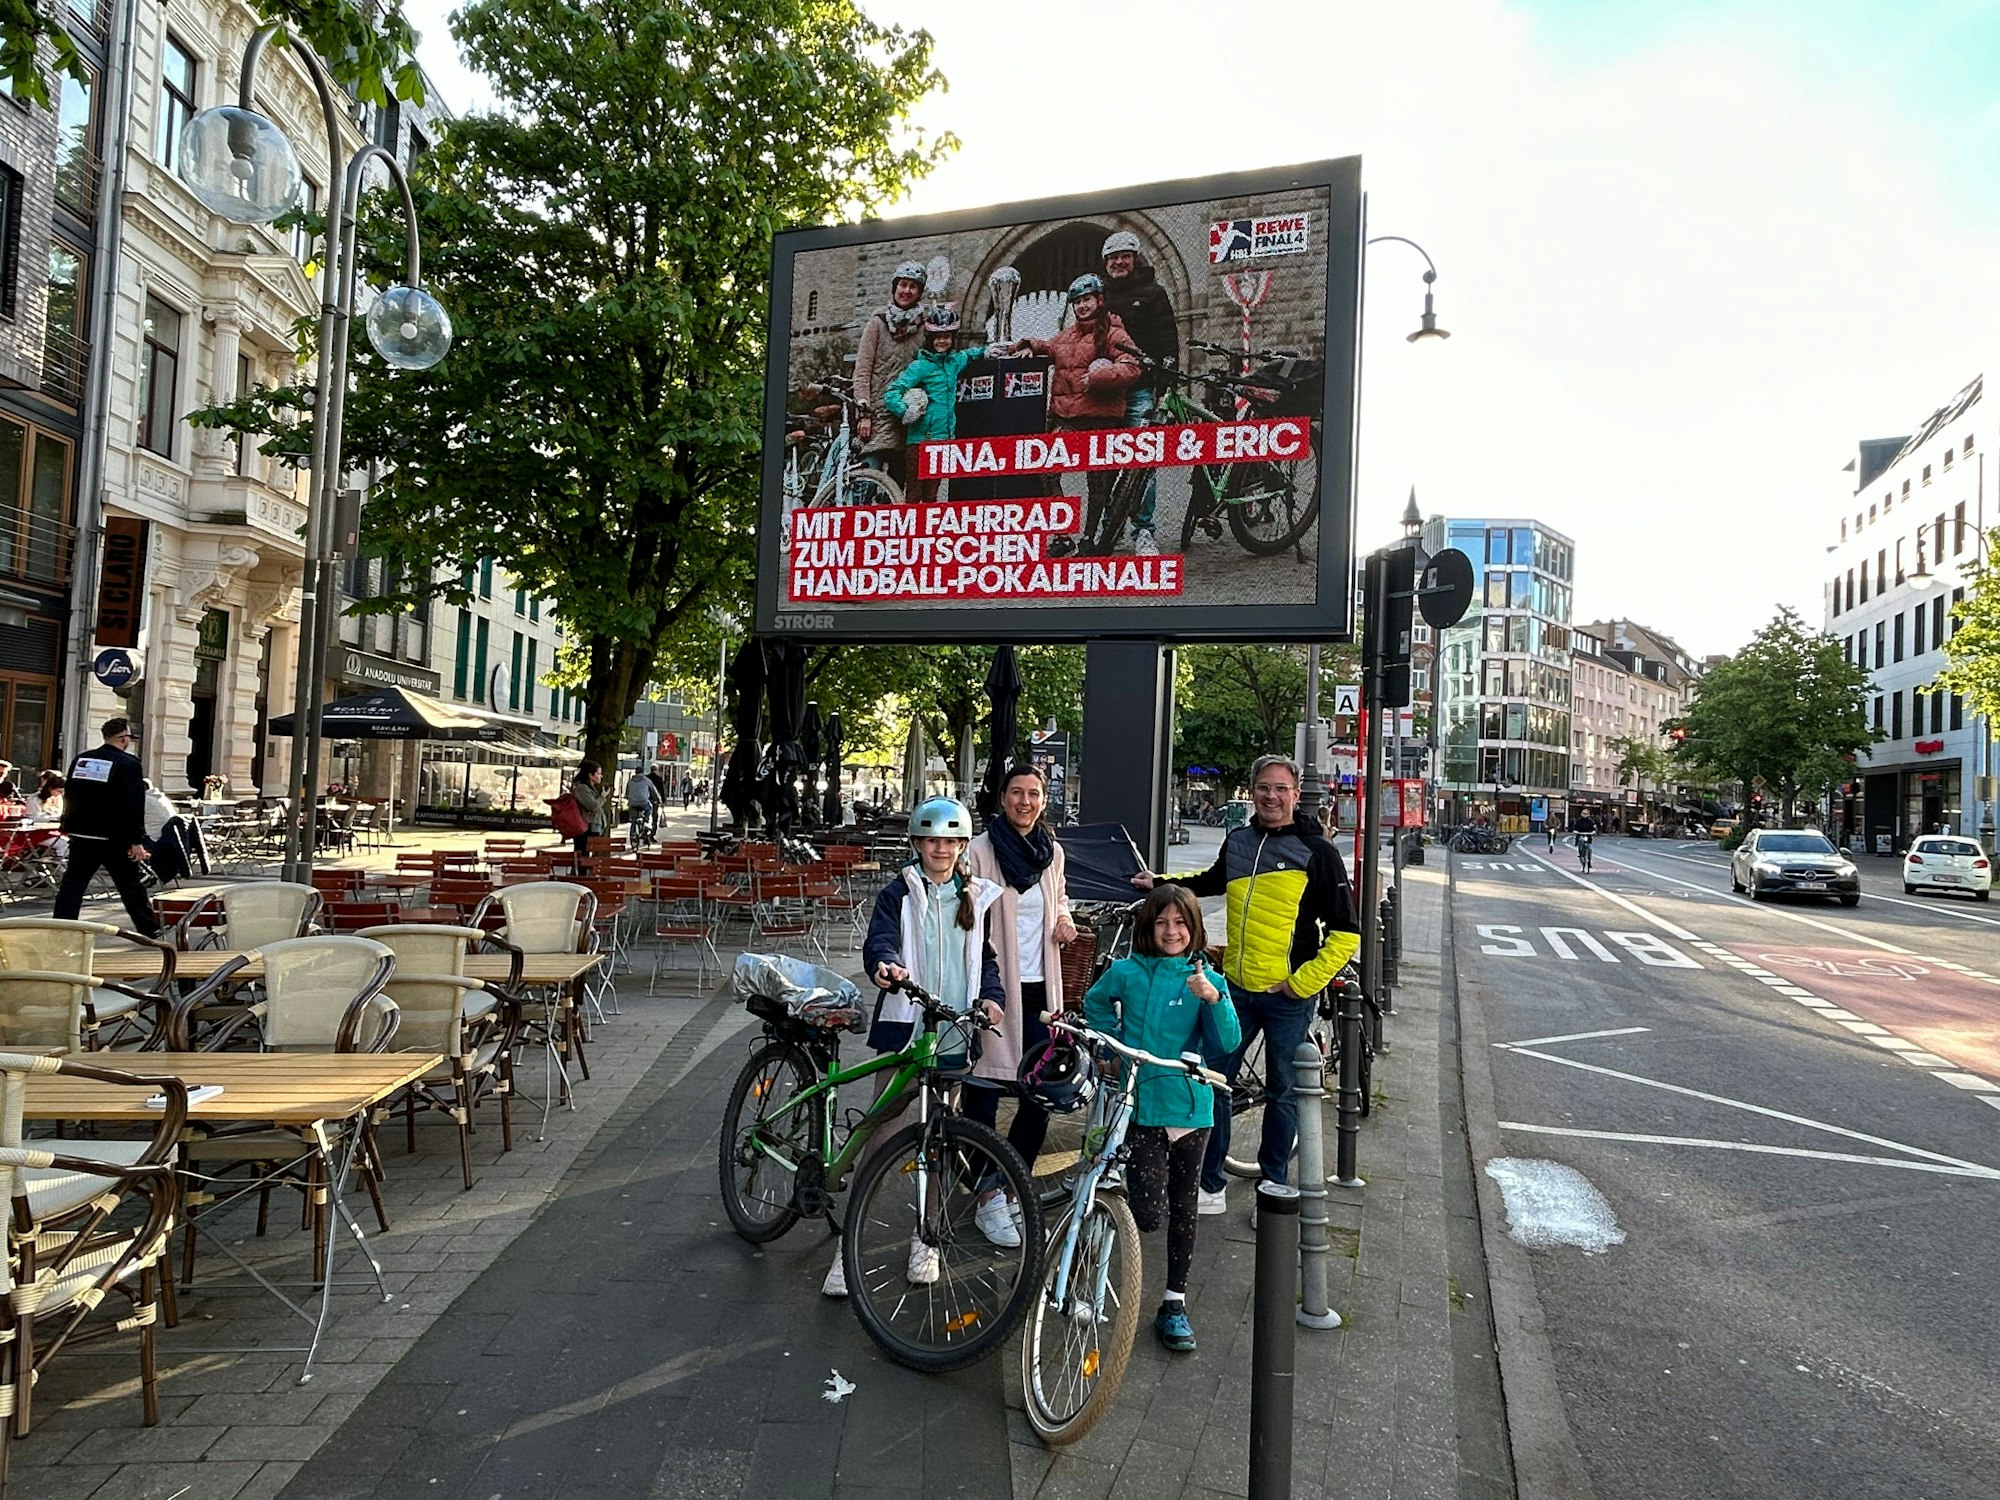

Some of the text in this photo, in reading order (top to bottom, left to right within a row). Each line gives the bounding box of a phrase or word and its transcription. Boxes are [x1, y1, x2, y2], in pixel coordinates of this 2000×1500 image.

[1256, 218, 1305, 235] REWE
[925, 422, 1302, 474] TINA, IDA, LISSI & ERIC
[796, 502, 1074, 539] MIT DEM FAHRRAD
[794, 534, 1041, 568] ZUM DEUTSCHEN
[101, 534, 135, 629] SI CLARO
[793, 560, 1177, 597] HANDBALL-POKALFINALE
[774, 614, 834, 630] STRÖER
[96, 658, 132, 677] Sion
[364, 667, 396, 684] ANADOLU
[1338, 695, 1355, 712] A
[1461, 862, 1546, 872] BUS
[1476, 924, 1705, 969] BUS
